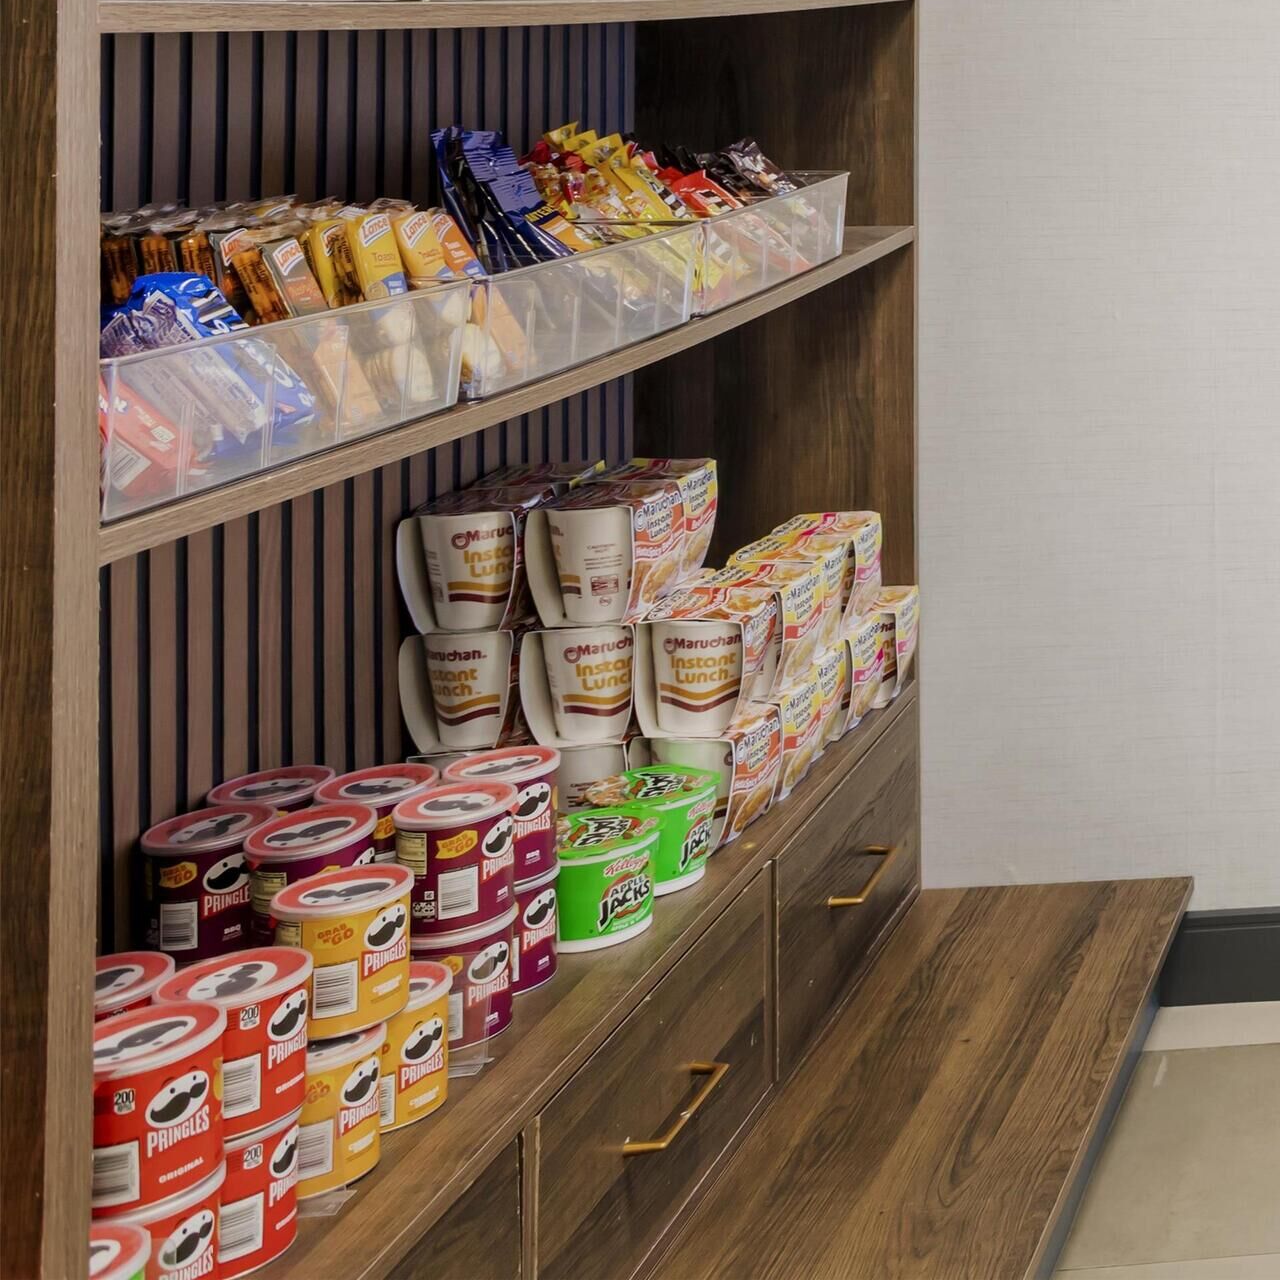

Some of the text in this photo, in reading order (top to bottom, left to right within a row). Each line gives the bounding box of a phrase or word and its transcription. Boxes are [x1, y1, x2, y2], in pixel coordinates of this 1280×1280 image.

[362, 217, 390, 240] Lance
[404, 215, 429, 240] Lance
[276, 243, 302, 268] Lance
[643, 490, 681, 516] Maruchan
[647, 510, 673, 530] Instant
[650, 523, 670, 539] Lunch
[673, 633, 742, 650] Maruchan
[670, 652, 737, 669] Instant
[674, 666, 729, 684] Lunch
[743, 717, 779, 747] Maruchan
[610, 874, 646, 898] APPLE
[599, 878, 650, 928] JACKS
[317, 921, 347, 940] GRAB
[331, 928, 354, 946] GO
[364, 934, 408, 977] PRINGLES
[240, 1006, 259, 1022] 200
[401, 1046, 444, 1090] PRINGLES
[113, 1089, 135, 1105] 200
[146, 1104, 211, 1158] PRINGLES
[243, 1145, 262, 1162] 200
[158, 1156, 205, 1184] ORIGINAL
